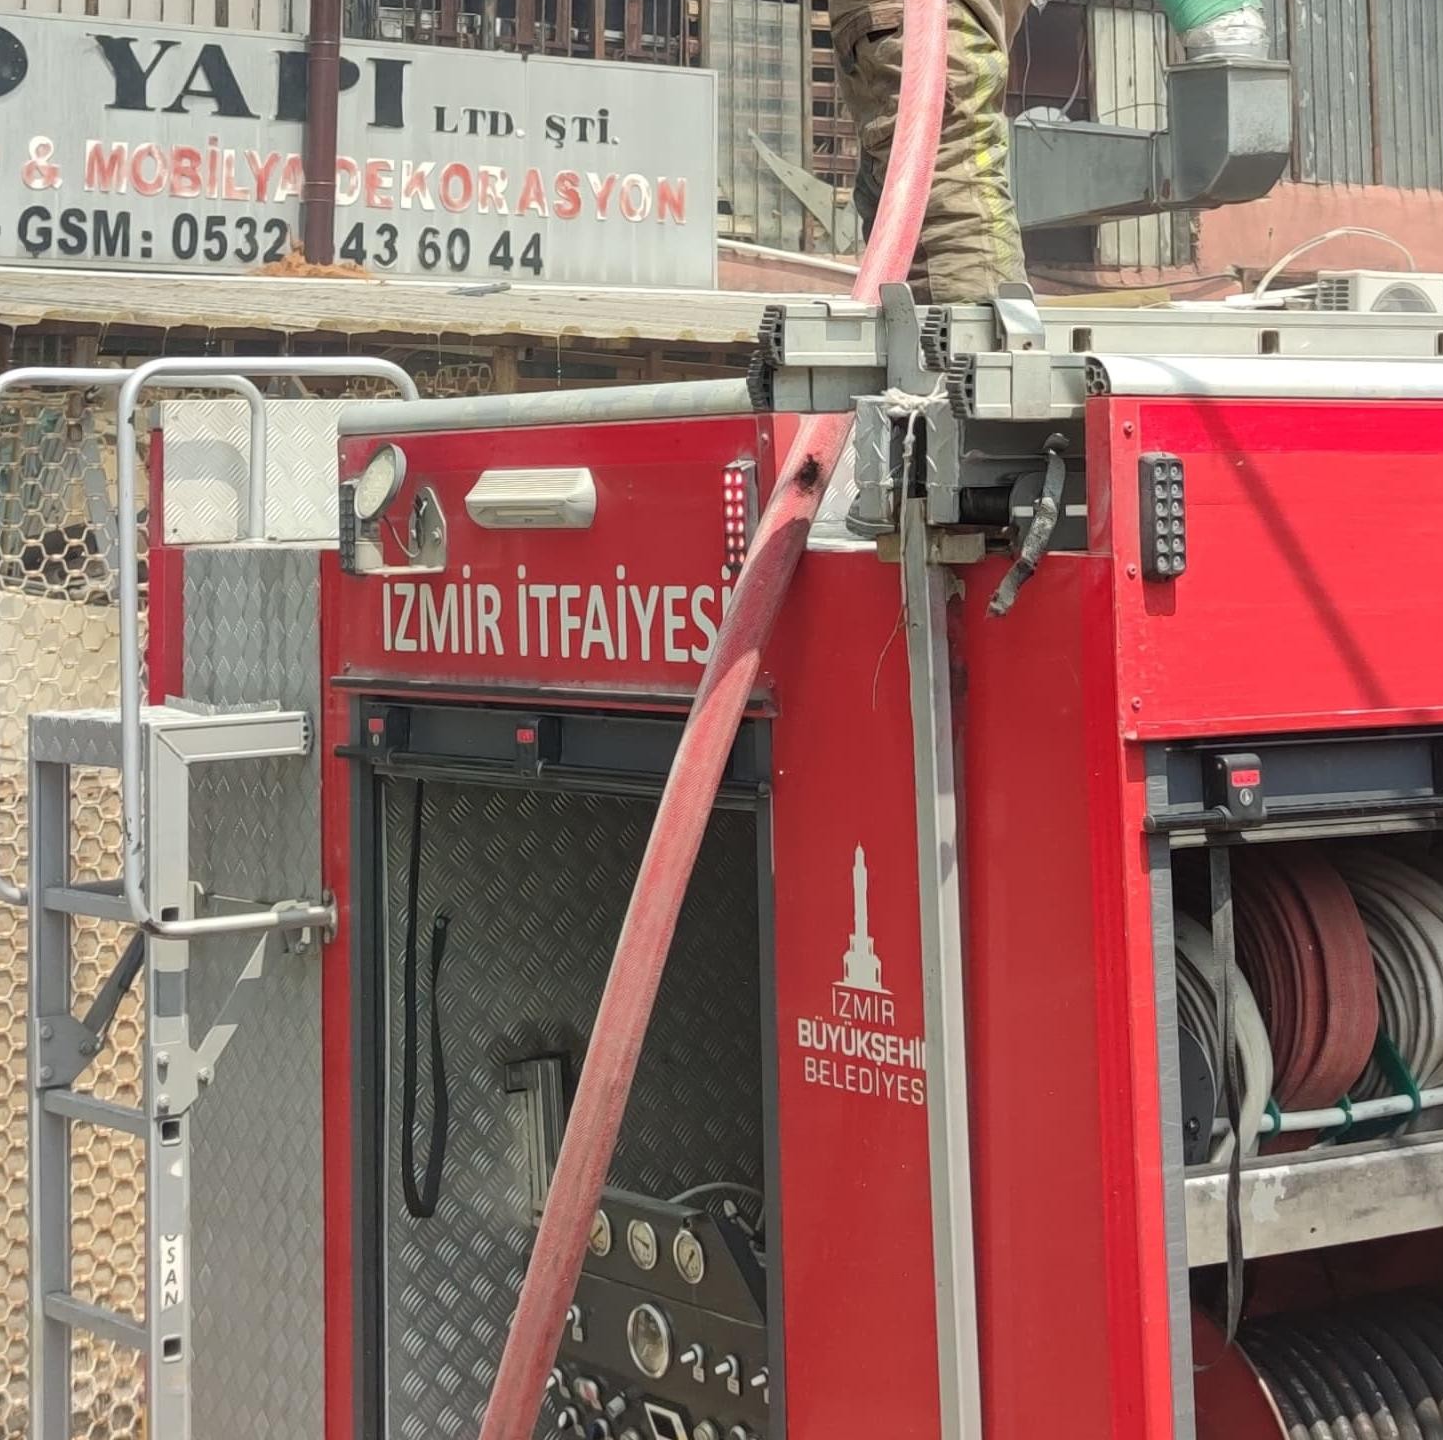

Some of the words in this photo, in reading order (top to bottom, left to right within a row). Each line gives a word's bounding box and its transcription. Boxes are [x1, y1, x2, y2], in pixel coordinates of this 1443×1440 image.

[86, 33, 412, 128] YAPI
[434, 106, 526, 138] LTD.
[545, 109, 620, 148] ŞTİ.
[22, 136, 62, 190] &
[85, 136, 304, 203] MOBİLYA
[335, 156, 686, 224] DEKORASYON
[17, 205, 153, 258] GSM:
[172, 212, 289, 263] 0532
[418, 227, 470, 272] 60
[488, 230, 544, 276] 44
[383, 564, 505, 655] İZMİR
